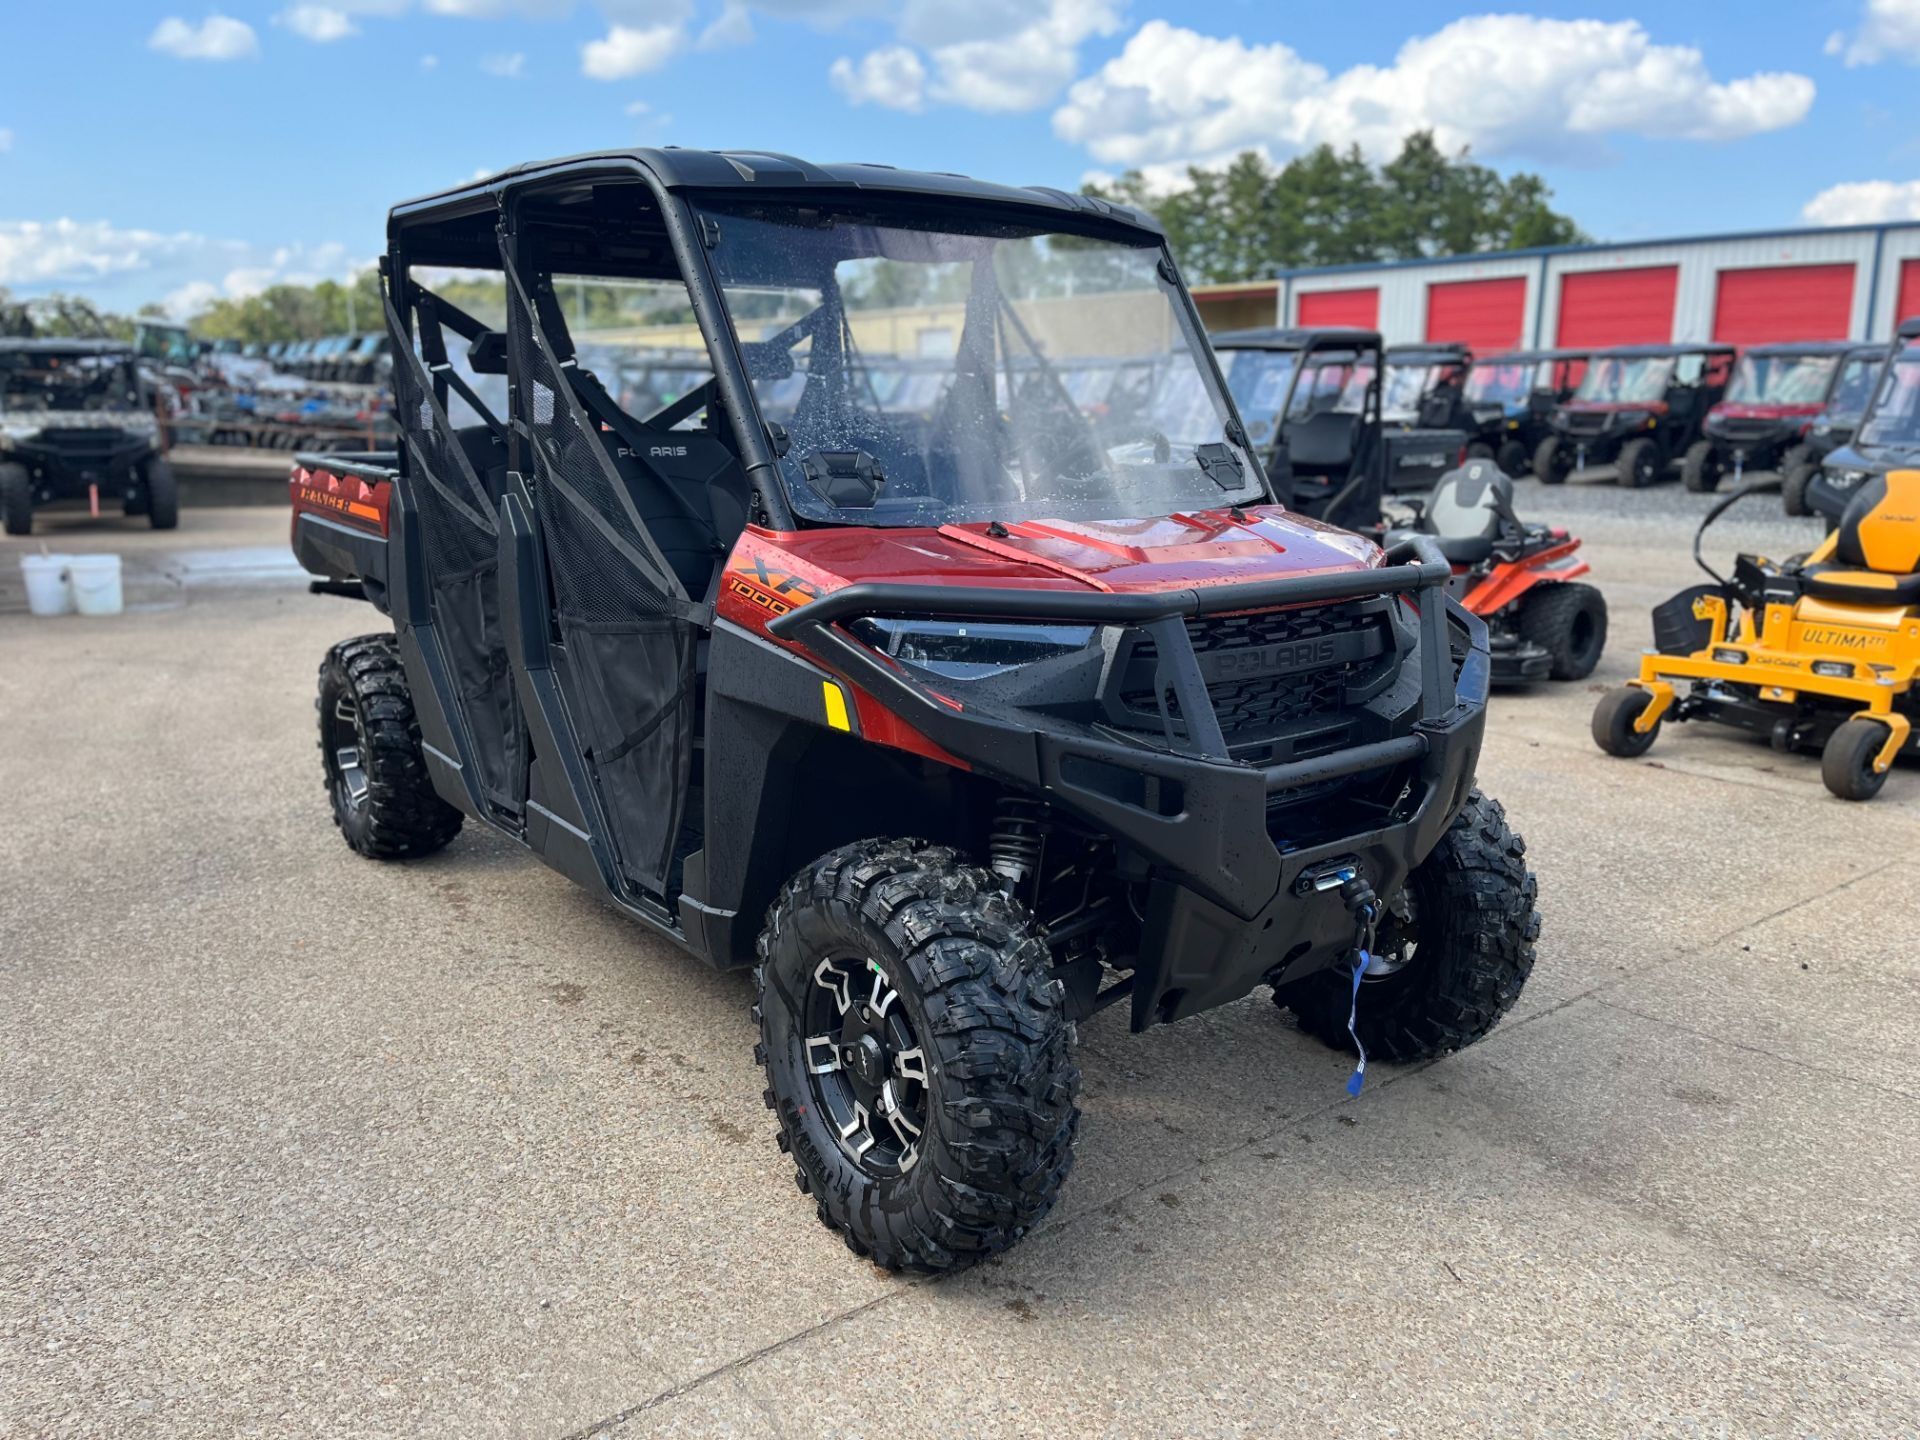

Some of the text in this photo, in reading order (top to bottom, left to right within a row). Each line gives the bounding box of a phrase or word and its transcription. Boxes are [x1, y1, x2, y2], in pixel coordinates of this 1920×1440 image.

[617, 446, 687, 458] POARIS
[735, 556, 826, 601] XP
[729, 579, 791, 617] 1000
[1803, 629, 1867, 648] ULTIMA
[1216, 640, 1334, 676] POLARIS
